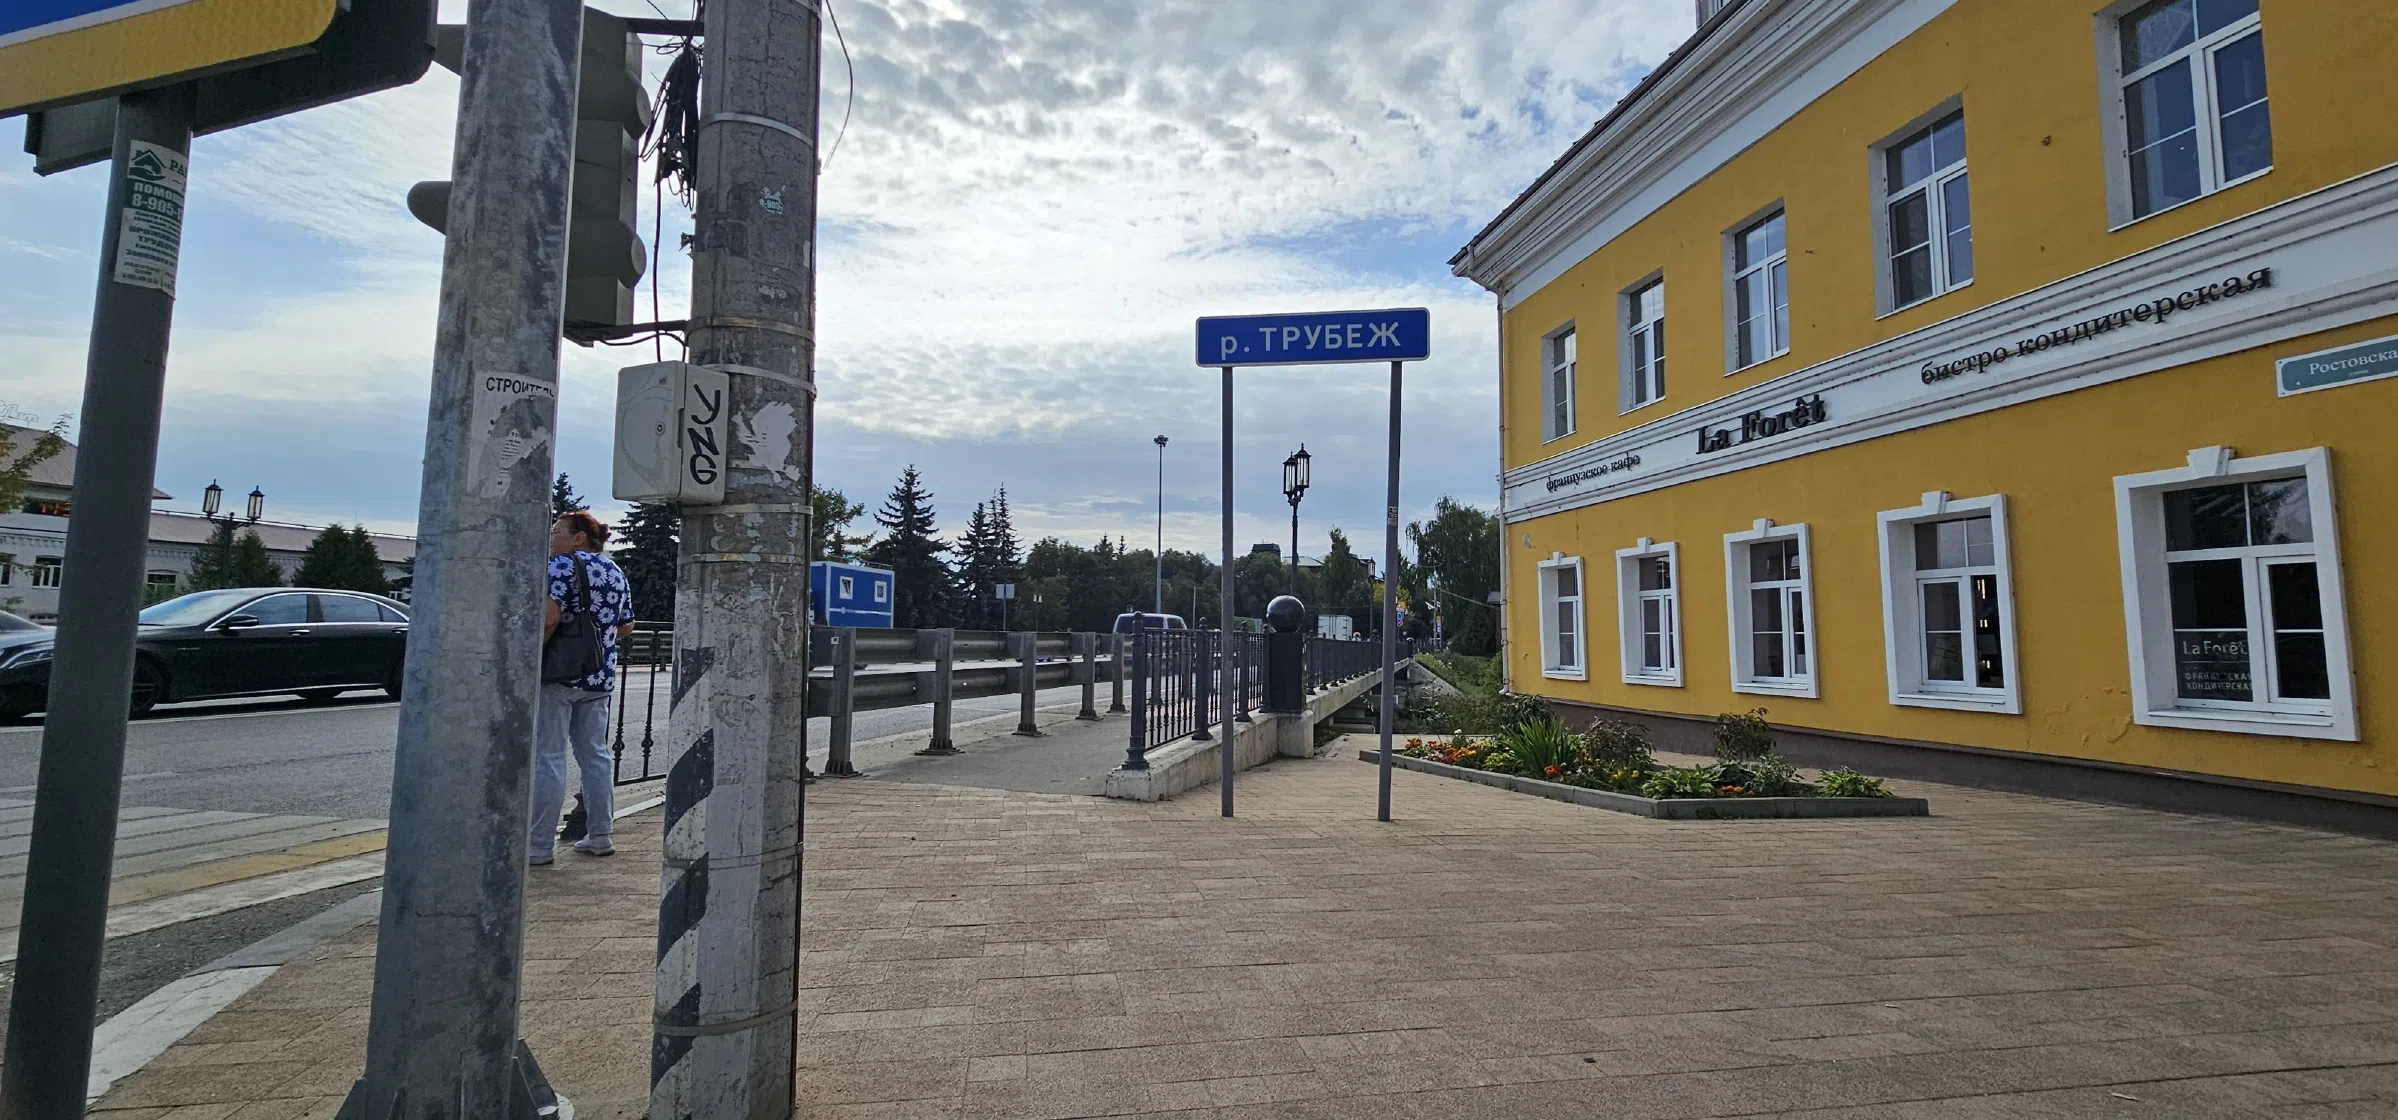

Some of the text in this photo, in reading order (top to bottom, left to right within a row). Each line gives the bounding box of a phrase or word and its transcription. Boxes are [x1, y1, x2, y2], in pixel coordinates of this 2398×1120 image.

[169, 159, 187, 178] РА
[1220, 321, 1402, 361] р. ТРУБЕЖ
[1921, 266, 2273, 385] бистро кондитерская
[1697, 394, 1827, 454] La Forêt
[1546, 451, 1641, 493] французское кафе
[2183, 641, 2201, 655] La
